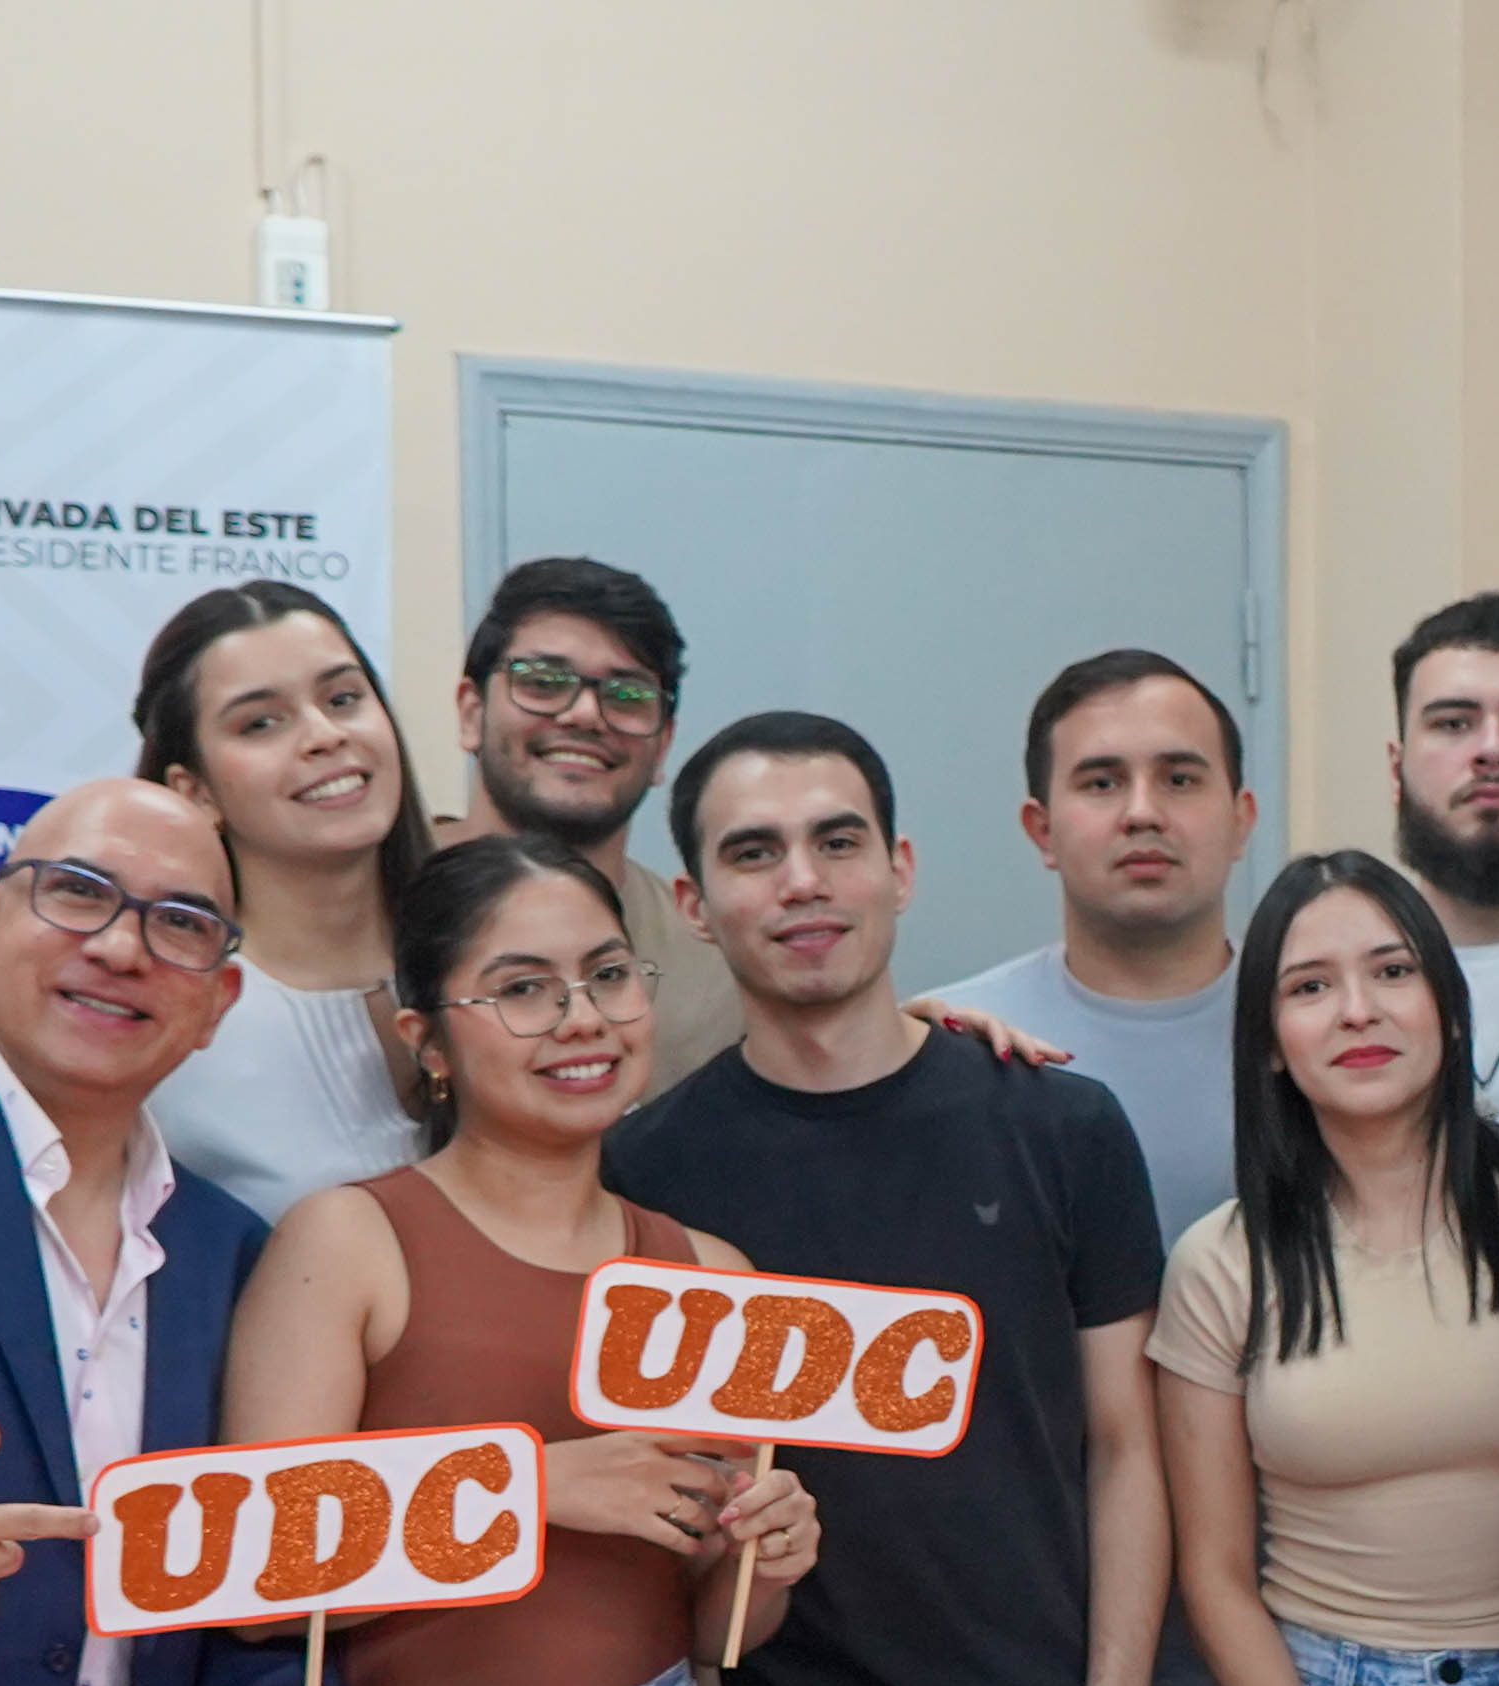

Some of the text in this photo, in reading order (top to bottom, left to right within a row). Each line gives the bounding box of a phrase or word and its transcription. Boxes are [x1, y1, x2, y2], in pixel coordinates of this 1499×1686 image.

[134, 505, 209, 536] DEL
[223, 511, 317, 541] ESTE
[189, 543, 349, 582] FRANCO
[597, 1284, 972, 1433] UDC
[113, 1442, 519, 1613] UDC
